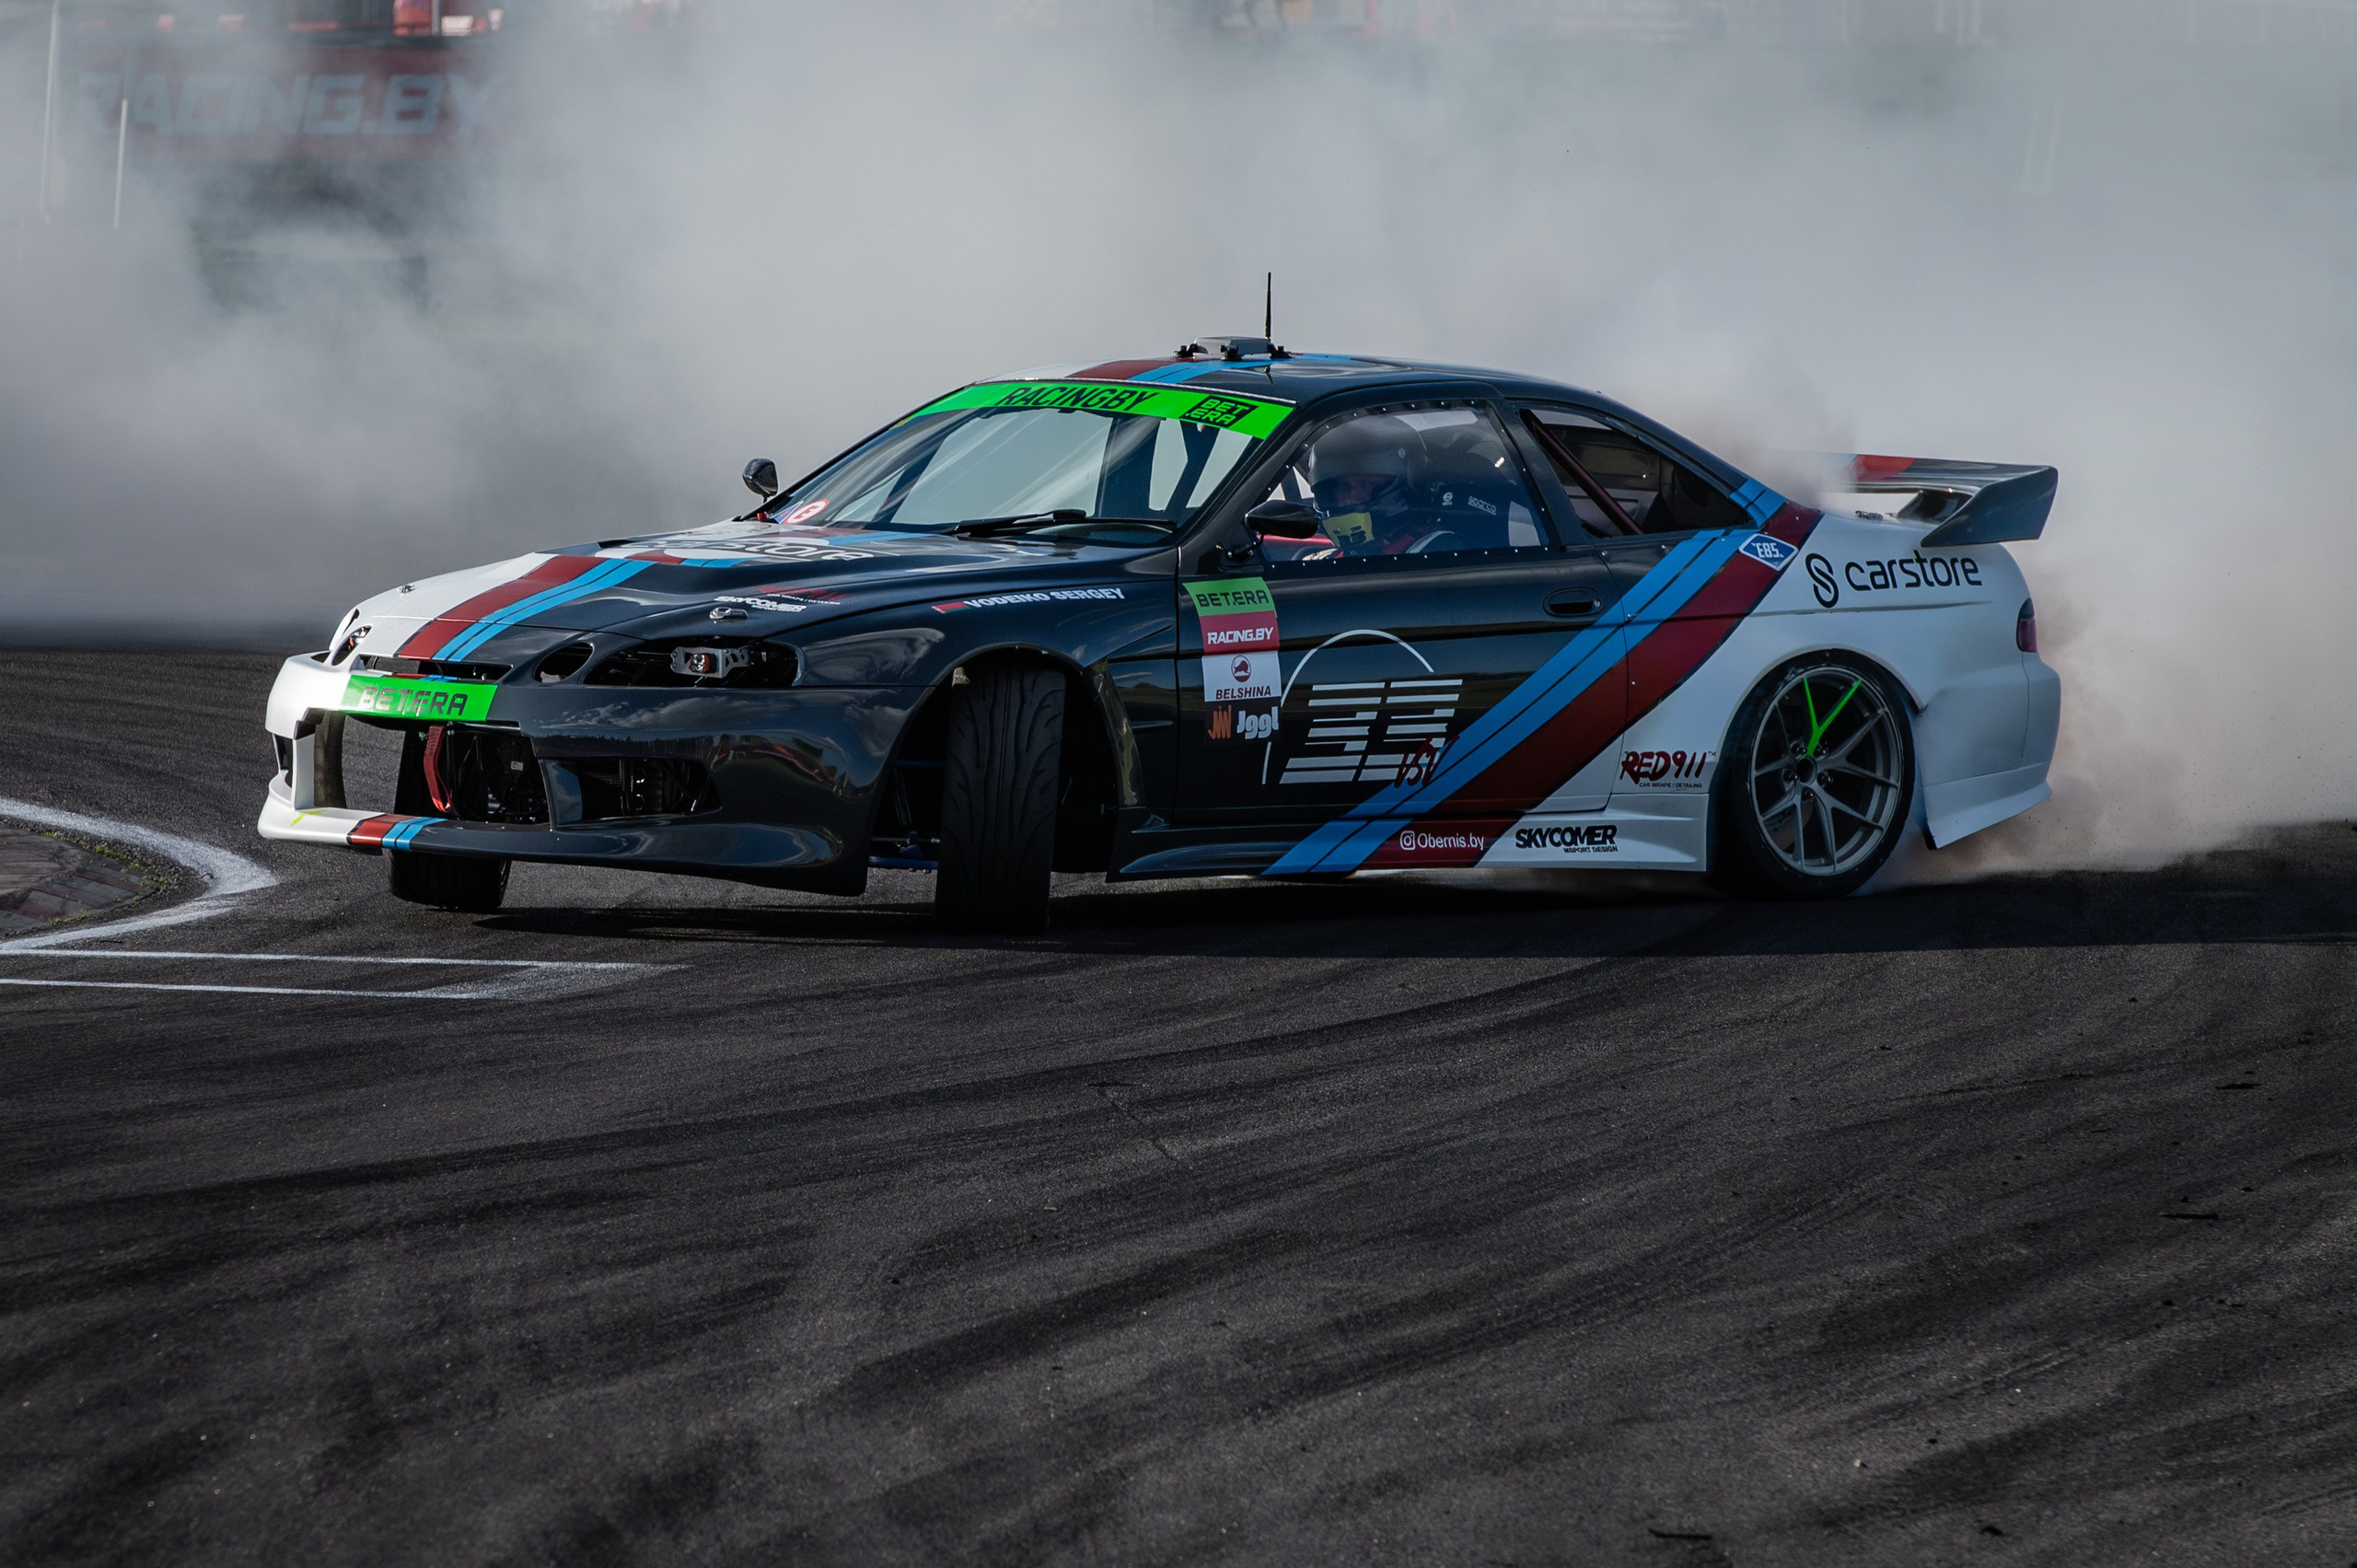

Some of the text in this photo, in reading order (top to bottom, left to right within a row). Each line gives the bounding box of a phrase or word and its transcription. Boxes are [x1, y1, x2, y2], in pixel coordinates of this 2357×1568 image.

[1200, 398, 1250, 415] BET
[1844, 550, 1982, 592] carstore
[963, 587, 1125, 608] VODEIKO SERGEY
[1206, 627, 1274, 645] RACING.BY
[1215, 685, 1271, 700] BELSHINA
[1620, 750, 1707, 784] RED911
[1515, 825, 1618, 849] SKYCOMER
